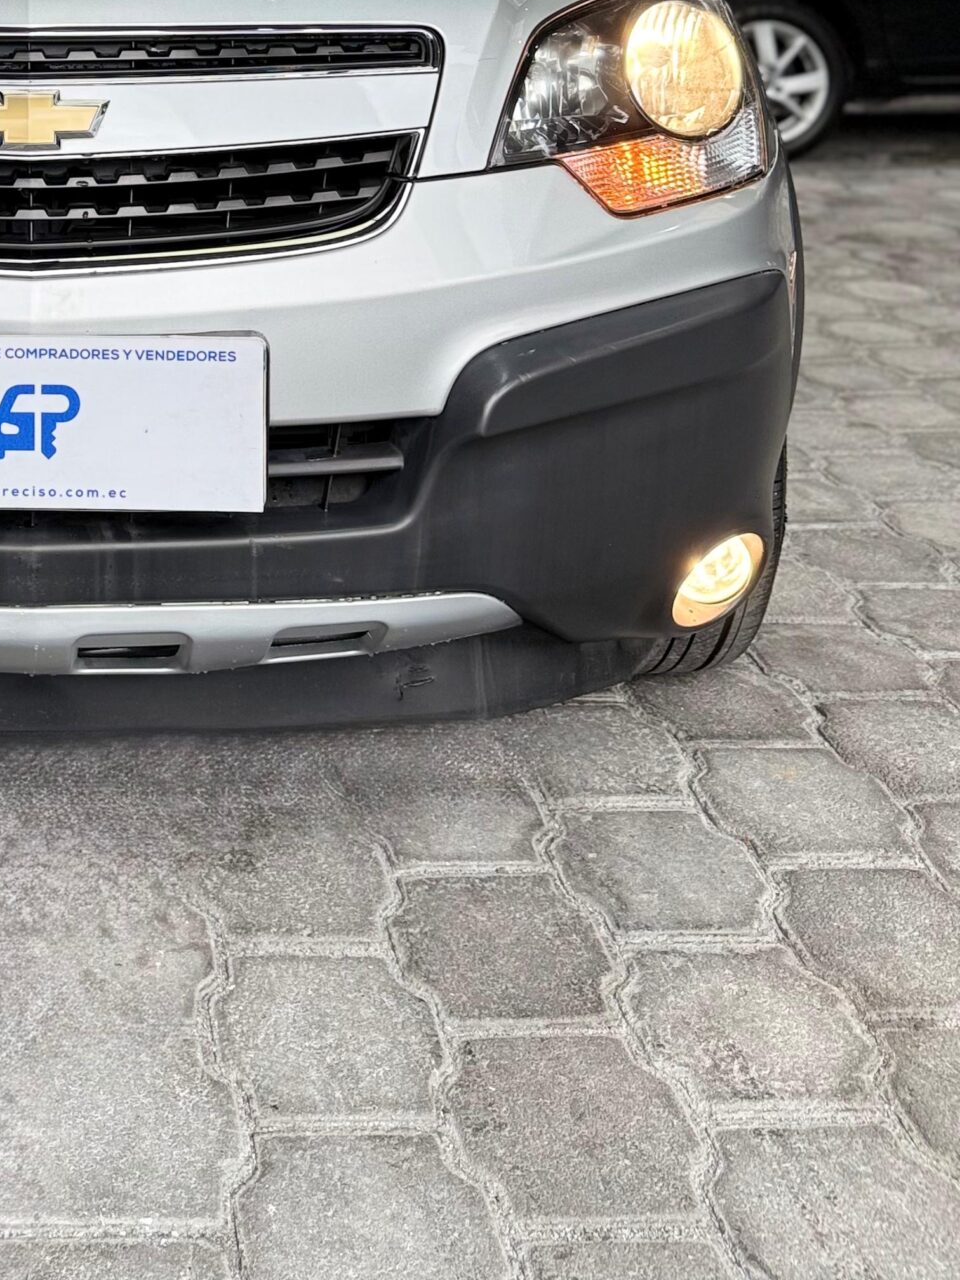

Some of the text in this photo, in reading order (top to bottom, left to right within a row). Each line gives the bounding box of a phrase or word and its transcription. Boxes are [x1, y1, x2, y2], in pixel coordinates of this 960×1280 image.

[4, 348, 120, 360] COMPRADORES
[123, 349, 133, 360] Y
[135, 350, 237, 362] VENDEDORES
